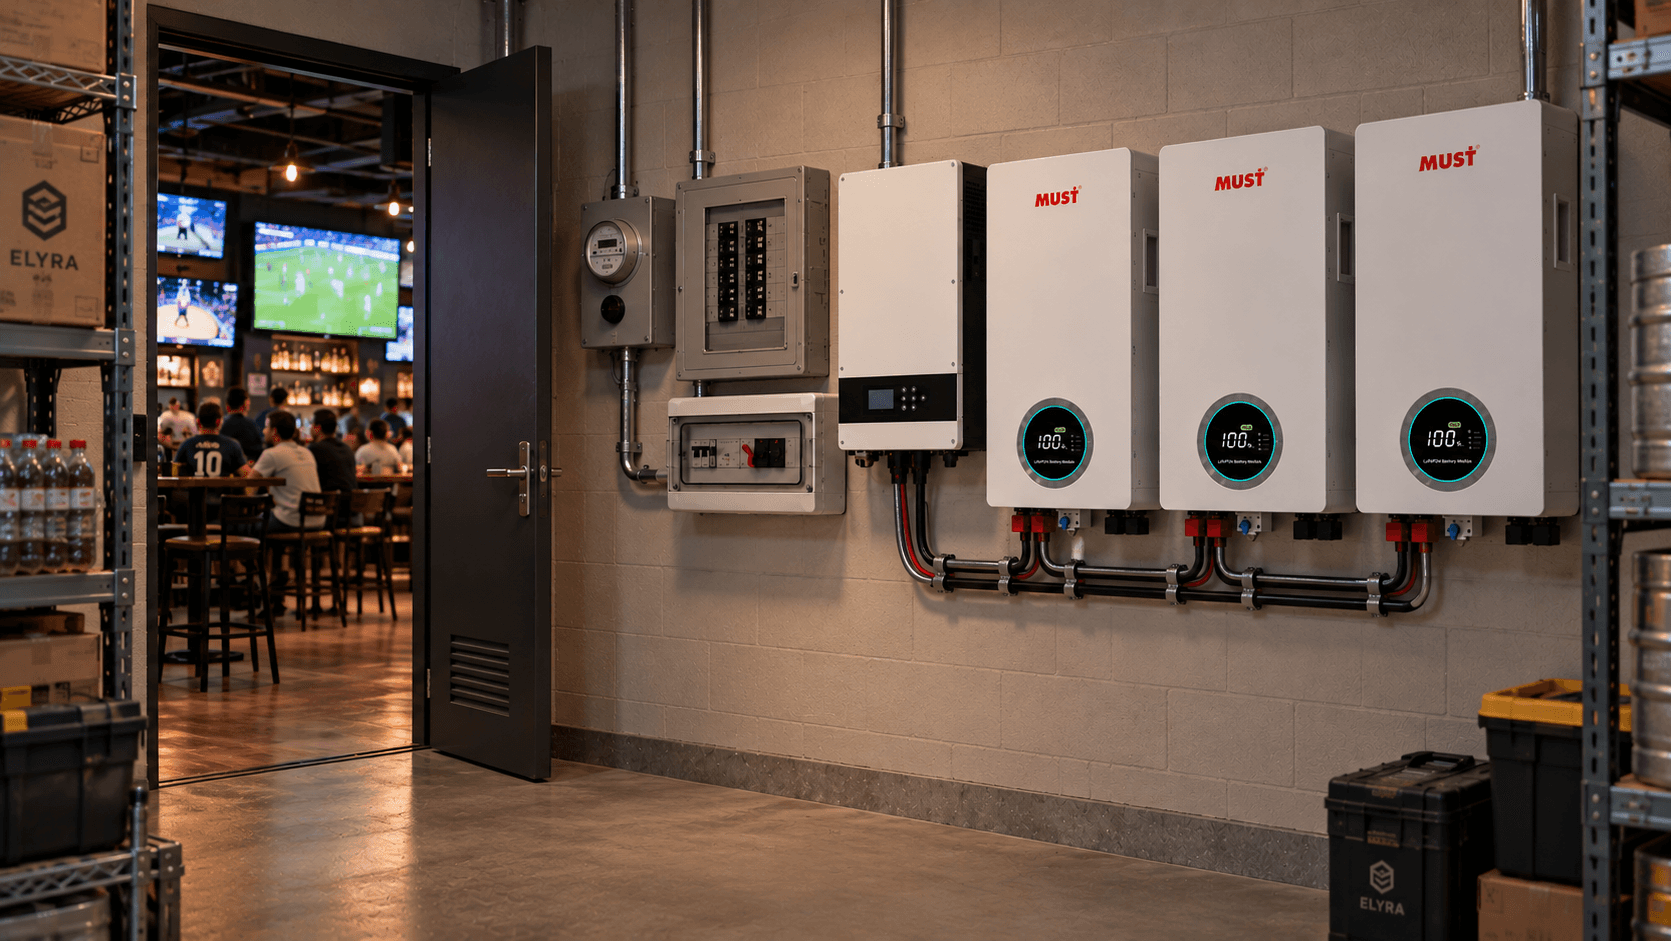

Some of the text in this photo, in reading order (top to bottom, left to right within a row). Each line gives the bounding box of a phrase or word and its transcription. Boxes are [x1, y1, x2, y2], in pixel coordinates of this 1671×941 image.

[10, 249, 79, 271] ELYRA
[193, 450, 222, 477] 10
[1360, 896, 1405, 916] ELYRA
